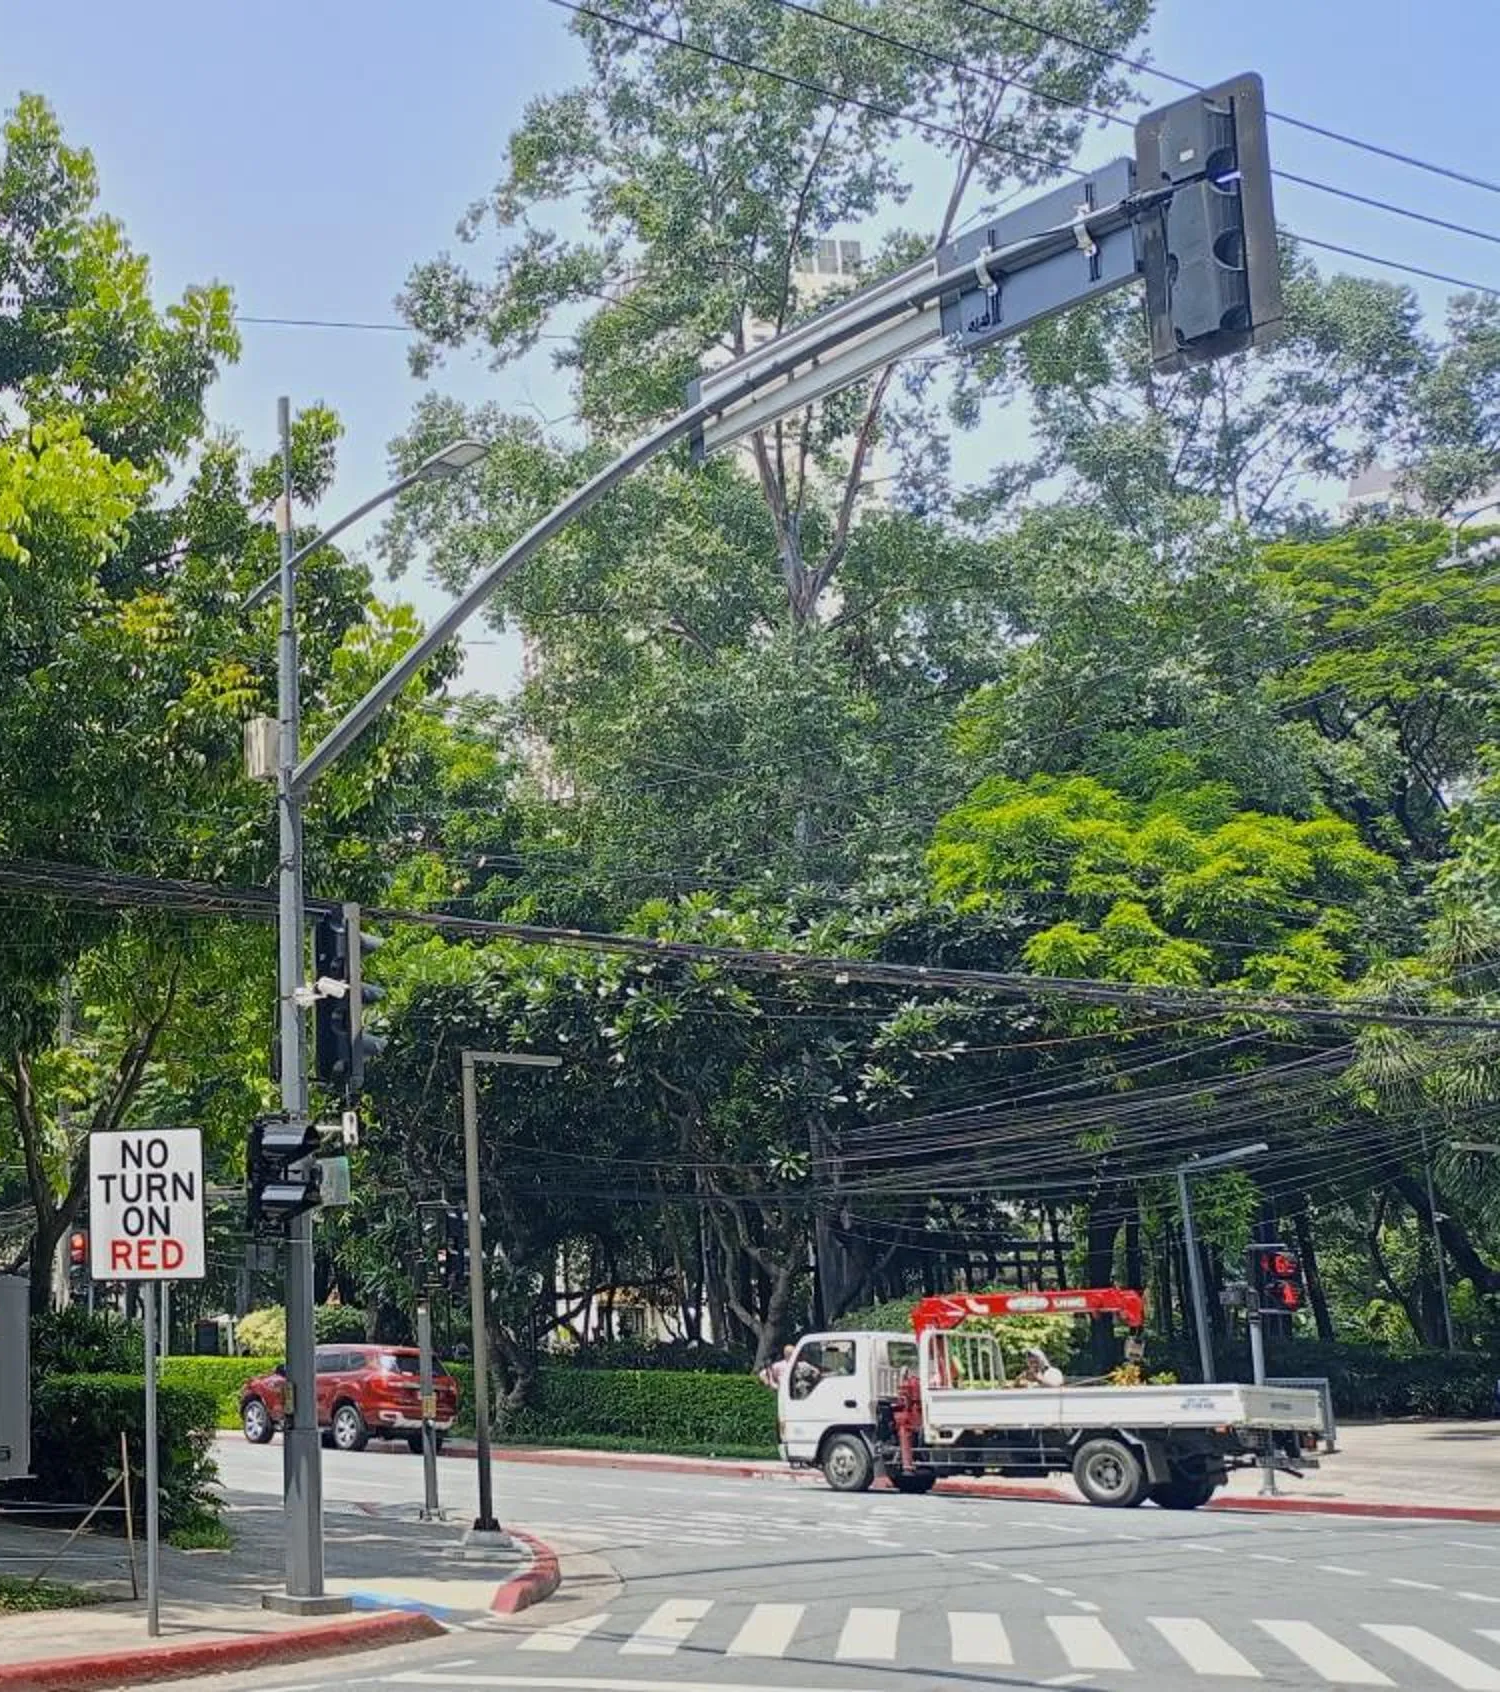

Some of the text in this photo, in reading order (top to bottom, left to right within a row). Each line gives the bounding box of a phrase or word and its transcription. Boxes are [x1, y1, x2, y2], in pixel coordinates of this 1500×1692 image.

[121, 1138, 169, 1169] NO
[97, 1171, 195, 1205] TURN
[122, 1206, 171, 1237] ON
[110, 1239, 184, 1271] RED
